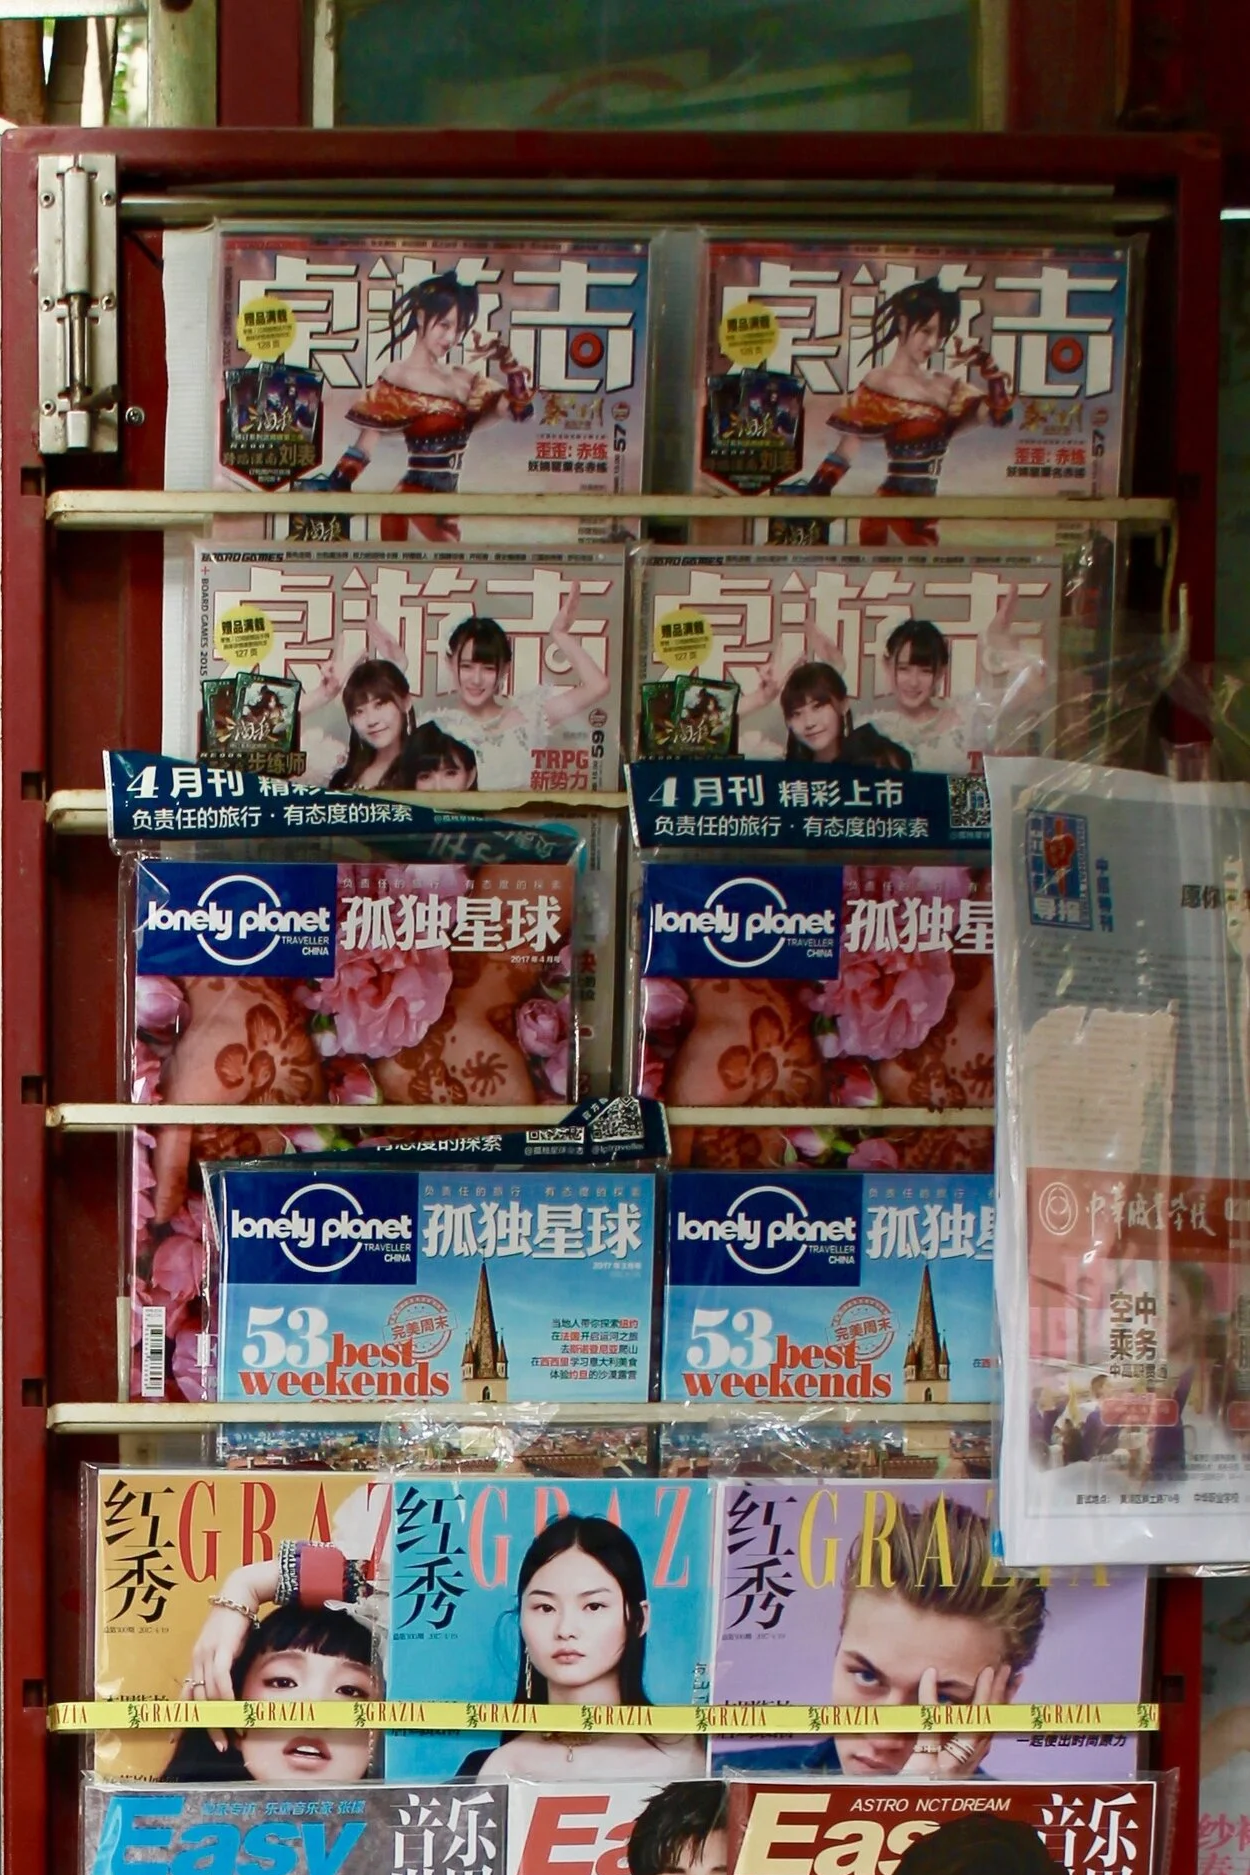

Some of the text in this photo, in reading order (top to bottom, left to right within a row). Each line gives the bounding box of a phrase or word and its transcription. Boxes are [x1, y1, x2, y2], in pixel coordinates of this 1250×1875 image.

[221, 617, 266, 635] 赠品满载
[531, 750, 589, 770] TRPG
[126, 766, 244, 799] 4月刊
[530, 770, 588, 790] 新势力
[648, 775, 903, 809] 4月刊 精彩上市
[282, 936, 330, 945] TRAVELLER
[341, 895, 561, 954] 孤独星球
[845, 898, 993, 955] 孤独星
[301, 947, 330, 956] CHINA
[231, 1209, 412, 1248] lonely planet
[422, 1200, 642, 1259] 孤独星球
[677, 1211, 856, 1250] lonely planet
[242, 1306, 331, 1369] 53
[391, 1315, 449, 1341] 完美周末
[551, 1317, 638, 1330] 当地人带你探索纽约
[551, 1330, 638, 1342] 在法国开启运河之旅
[686, 1308, 773, 1370] 53
[329, 1332, 427, 1371] best
[531, 1356, 638, 1368] 在西西里学习意大利美食
[770, 1334, 865, 1371] best
[238, 1361, 450, 1398] weekends
[549, 1368, 637, 1381] 体验约旦的沙漠露营
[682, 1362, 892, 1398] weekends
[104, 1479, 180, 1624] 红秀
[394, 1486, 470, 1631] 红秀
[479, 1704, 538, 1724] GRAZIA
[707, 1705, 766, 1726] GRAZIA
[851, 1797, 1011, 1812] ASTRO NCT DREAM
